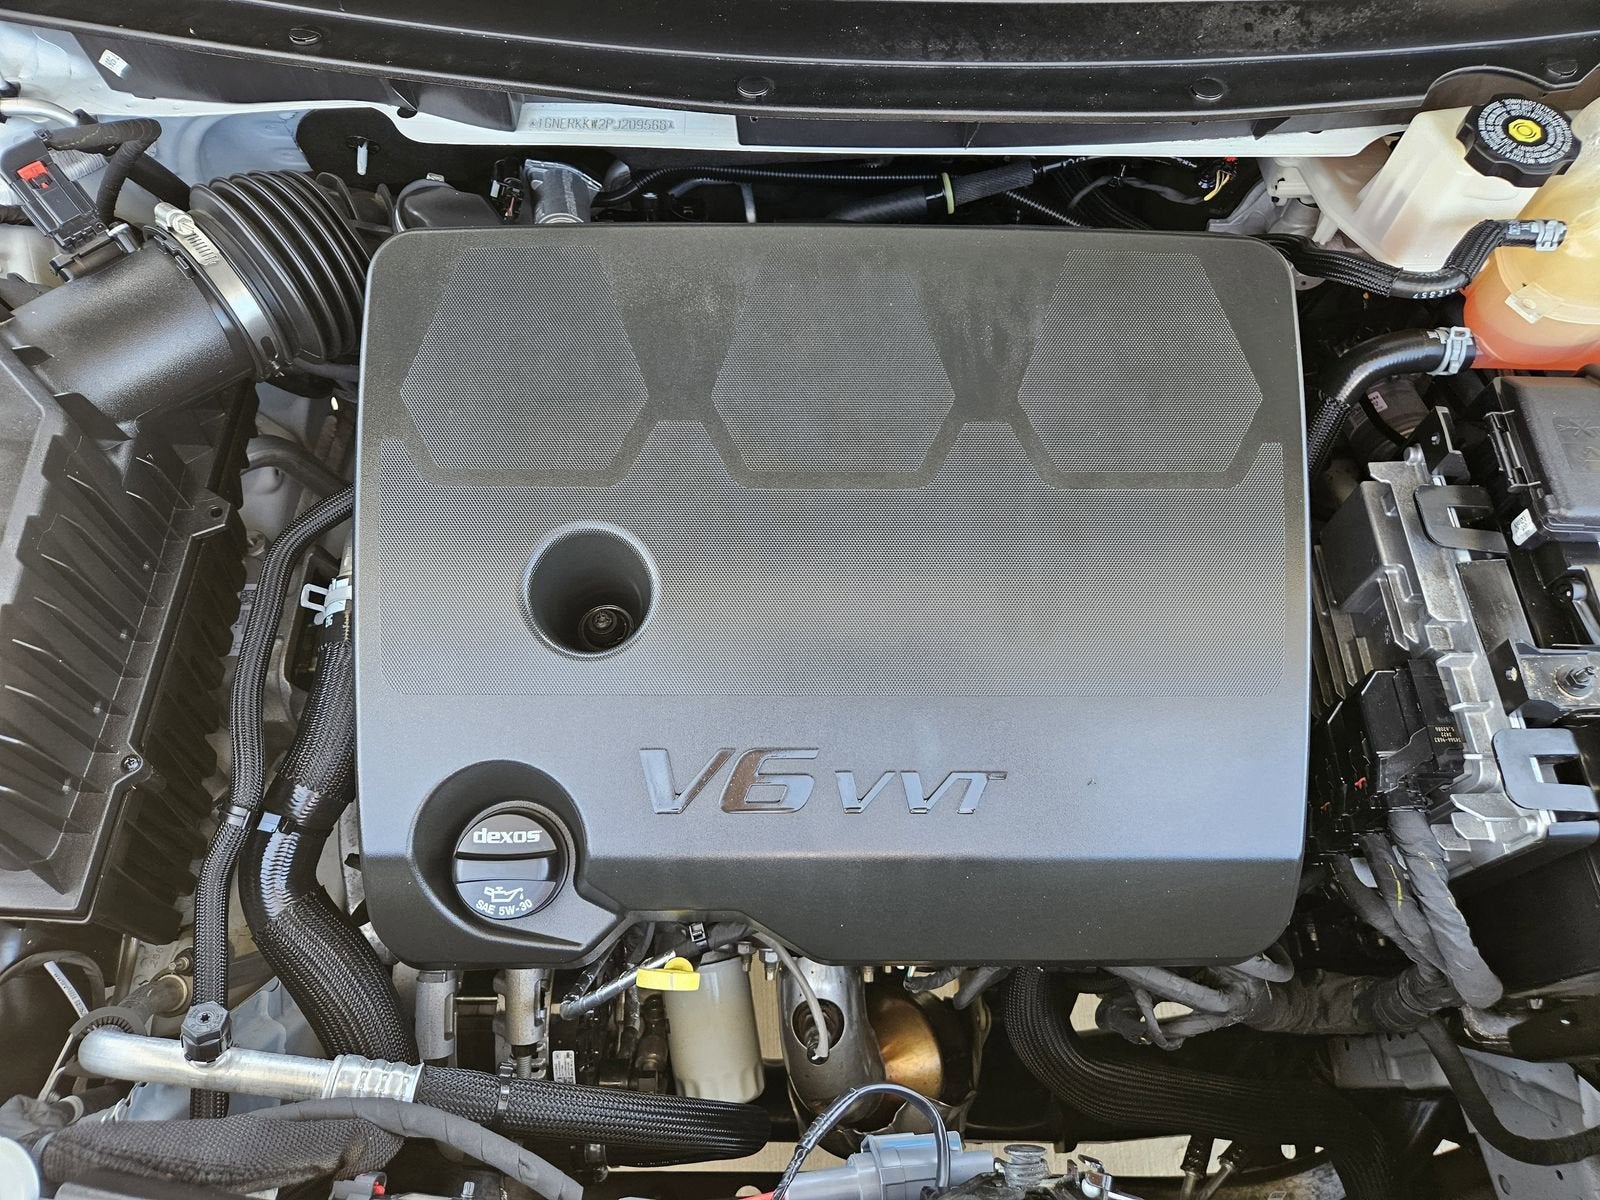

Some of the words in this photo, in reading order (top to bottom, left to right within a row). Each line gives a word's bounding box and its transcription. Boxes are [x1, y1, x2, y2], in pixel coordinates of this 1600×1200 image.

[639, 748, 820, 814] V6
[834, 769, 1009, 814] VVT
[473, 828, 542, 843] dexos
[475, 899, 496, 914] SAE
[498, 899, 533, 915] 5W-30
